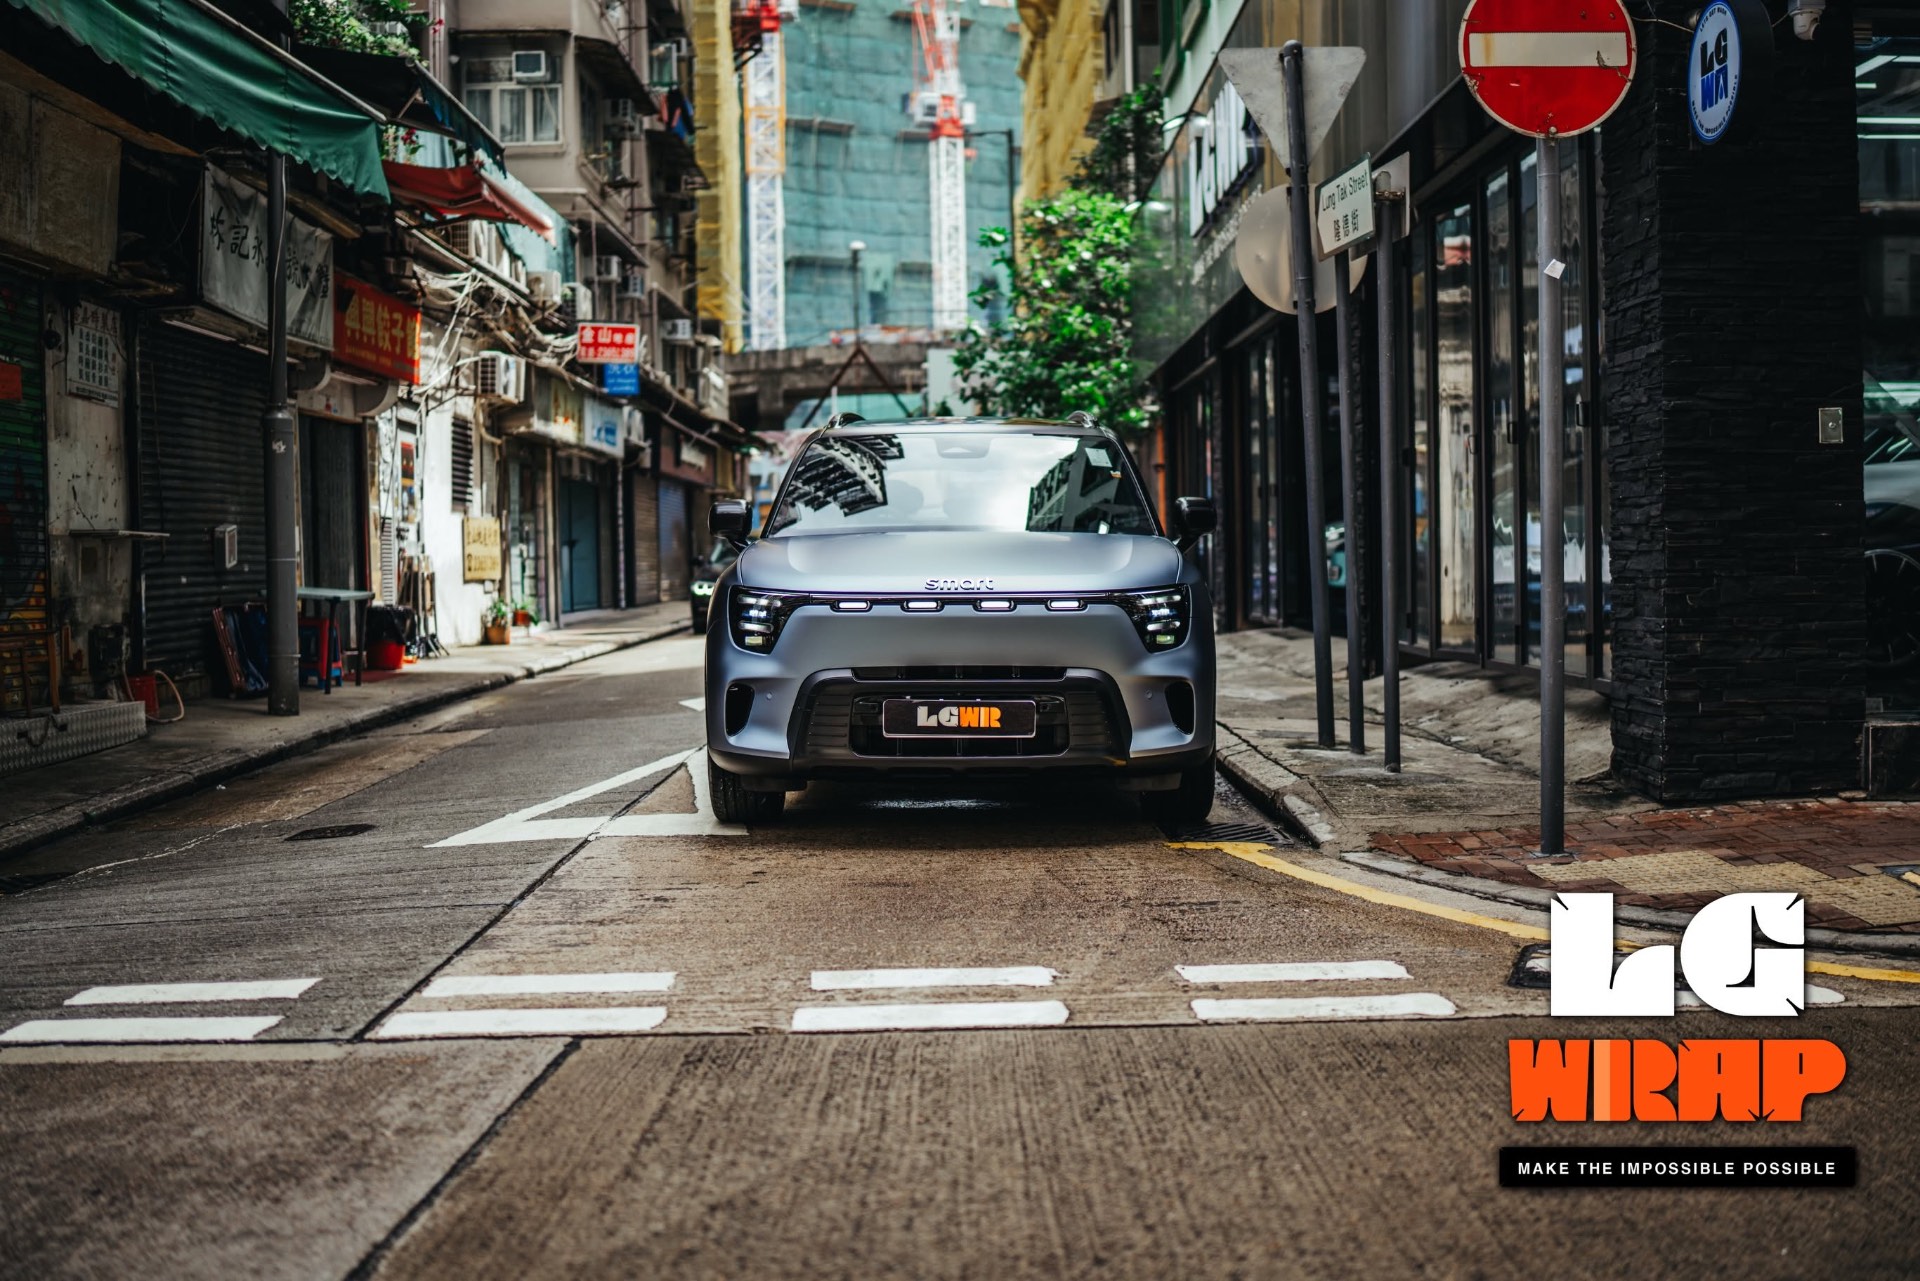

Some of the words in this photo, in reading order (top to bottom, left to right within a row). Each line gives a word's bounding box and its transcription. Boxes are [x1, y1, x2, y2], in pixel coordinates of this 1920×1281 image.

[1700, 28, 1728, 79] LG
[1322, 192, 1336, 211] Lung
[1336, 181, 1348, 202] Tak
[1348, 169, 1368, 195] Street
[924, 577, 994, 591] smart
